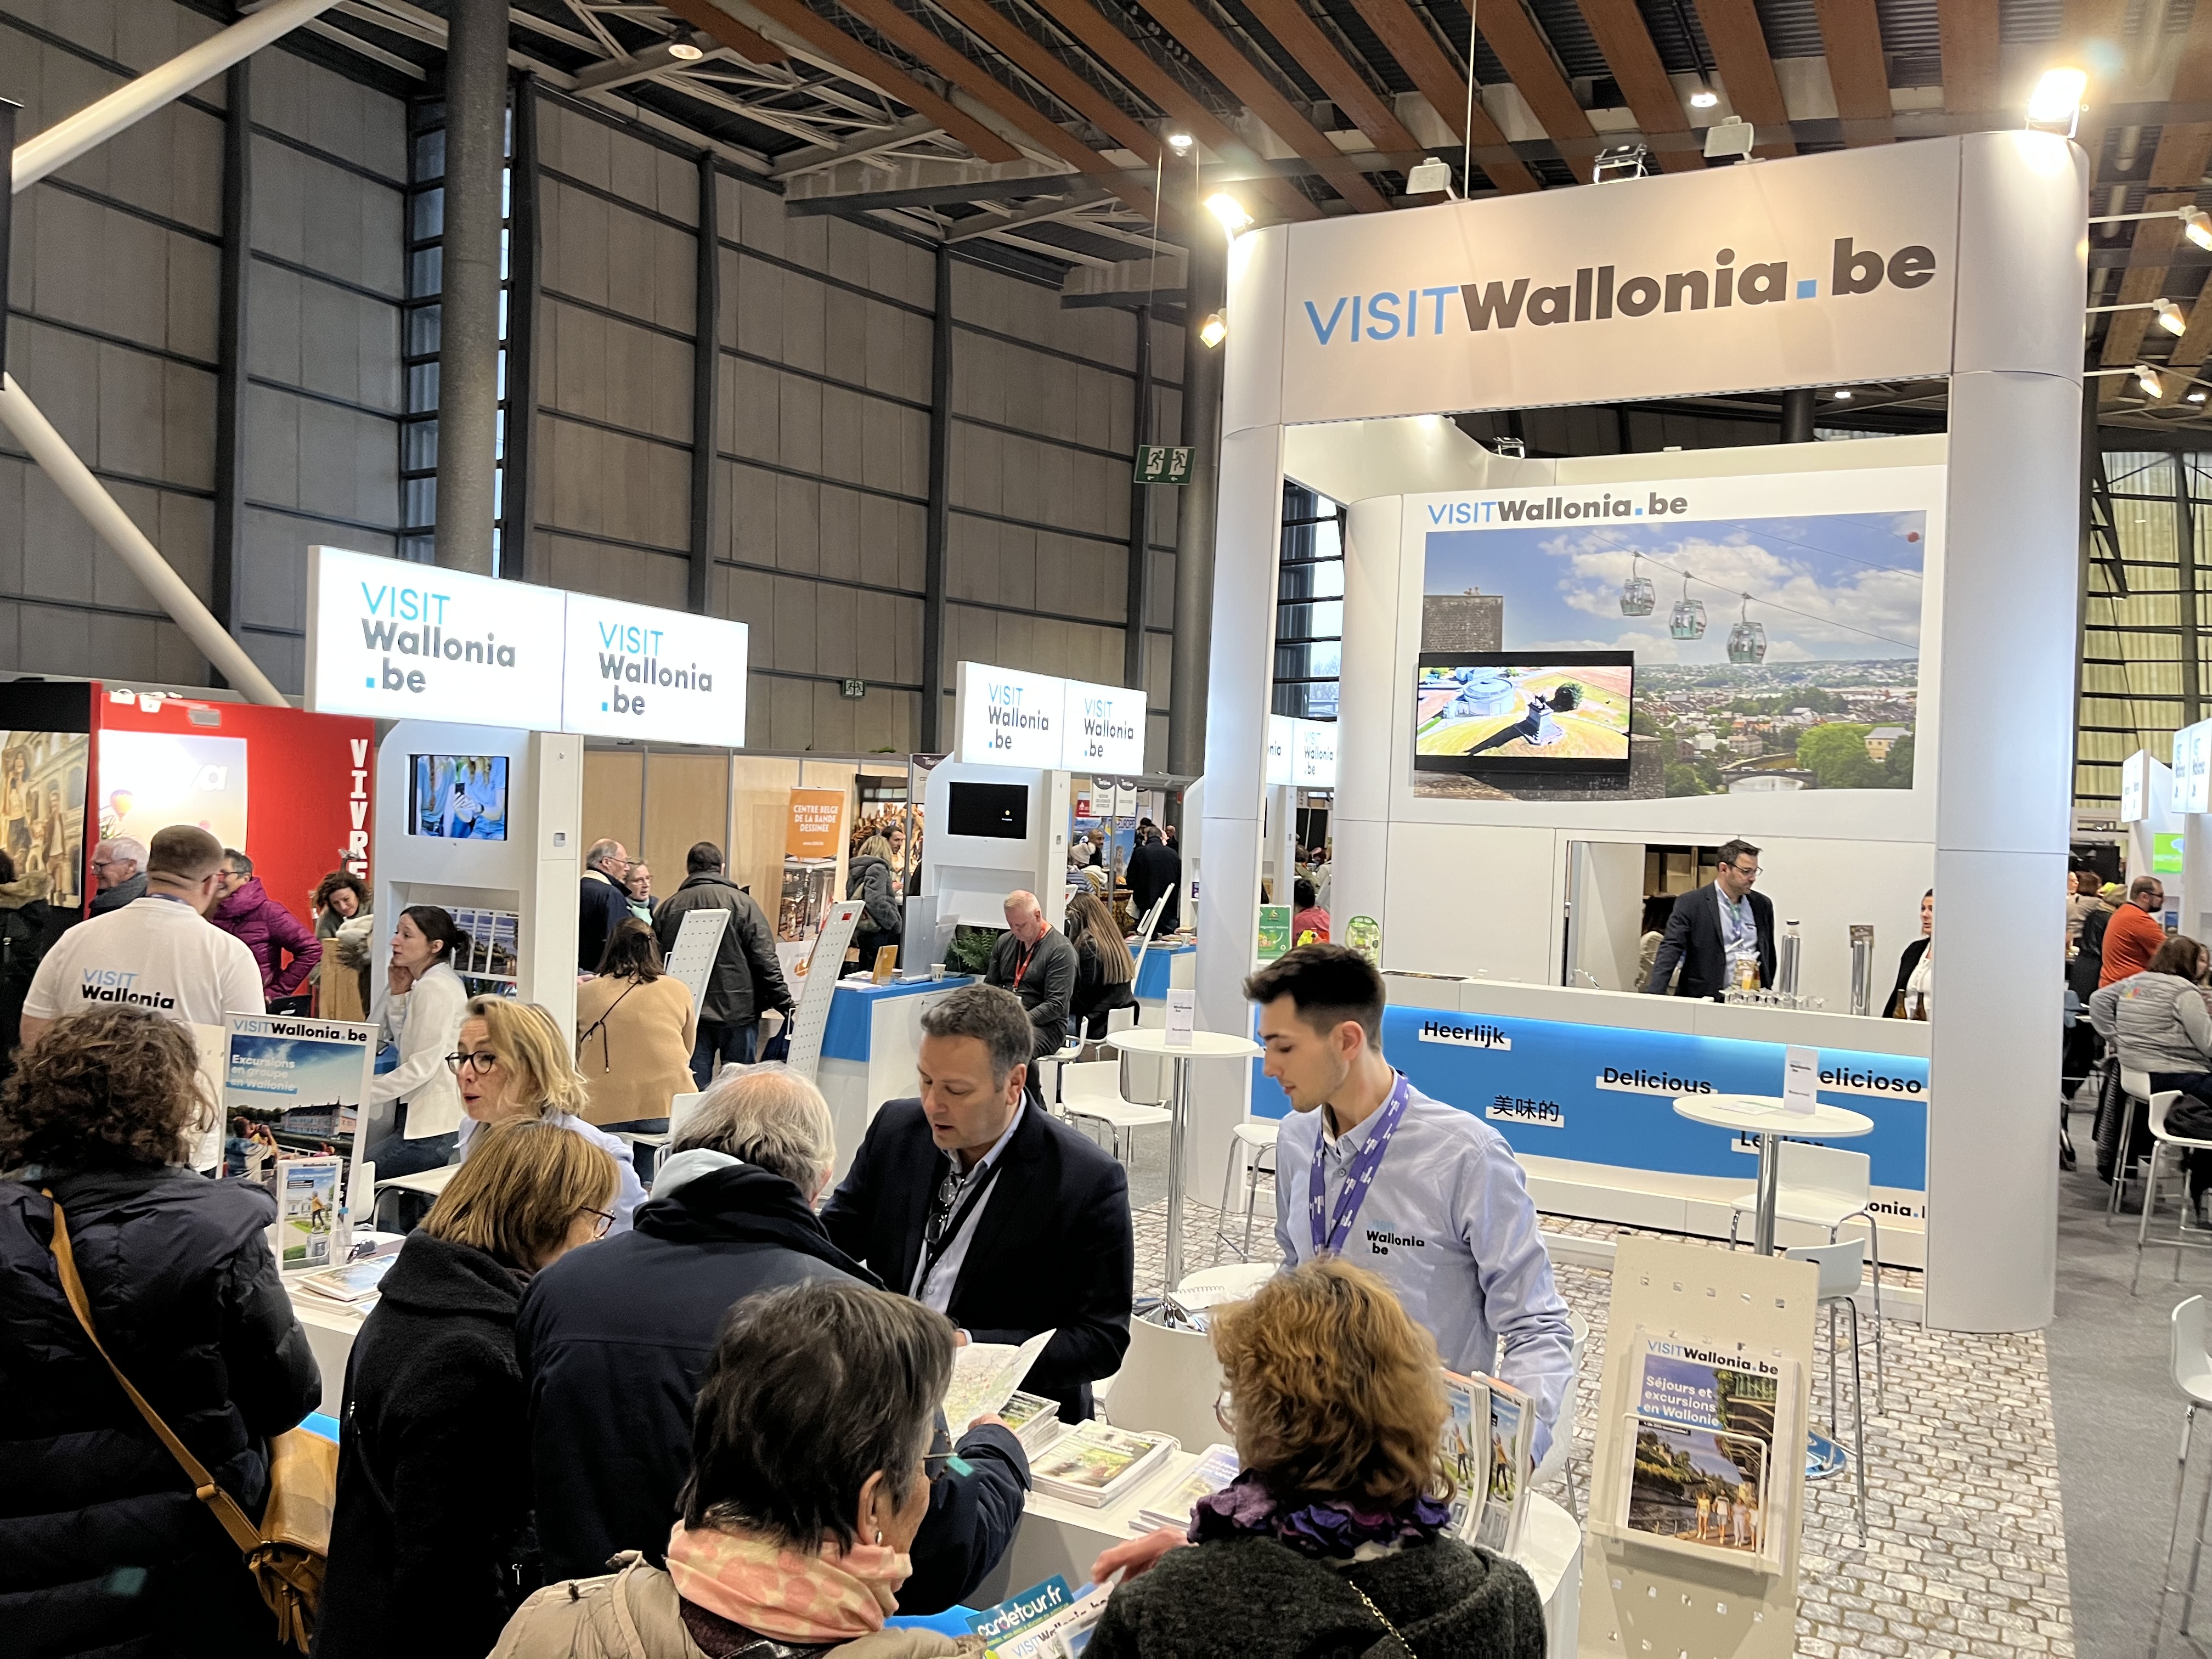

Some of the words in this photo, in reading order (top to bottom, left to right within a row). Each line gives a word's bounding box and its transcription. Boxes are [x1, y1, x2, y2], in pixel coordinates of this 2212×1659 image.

[1304, 237, 1937, 346] VISITWallonia.be
[1427, 492, 1689, 525] VISITWallonia.be
[360, 581, 450, 624] VISIT
[360, 618, 516, 668] Wallonia
[599, 621, 663, 656] VISIT
[366, 657, 426, 693] .be
[599, 652, 712, 692] Wallonia
[601, 686, 646, 715] .be
[989, 683, 1024, 706] VISIT
[989, 706, 1049, 730] Wallonia
[1084, 697, 1113, 718] VISIT
[989, 729, 1012, 749] .be
[1084, 718, 1134, 740] Wallonia
[1084, 738, 1104, 758] .be
[1304, 746, 1333, 760] Wallonia
[793, 804, 819, 814] CENTRE
[820, 805, 838, 814] BELGE
[794, 814, 804, 822] DE
[804, 815, 813, 823] LA
[814, 815, 836, 823] BANDE
[83, 968, 139, 988] VISIT
[82, 984, 175, 1009] Wallonia
[233, 1019, 368, 1042] VISITWallonia.be
[1424, 1021, 1505, 1048] Heerlijk
[231, 1066, 245, 1075] en
[246, 1068, 289, 1079] groupe
[232, 1054, 296, 1069] Excursions
[230, 1078, 244, 1087] en
[246, 1079, 295, 1092] Wallonie
[1603, 1067, 1712, 1094] Delicious
[1819, 1067, 1922, 1094] elicioso
[1493, 1095, 1560, 1122] 美味的
[1367, 1230, 1425, 1246] Wallonia
[1647, 1339, 1779, 1375] VISITWallonia.be
[1646, 1376, 1696, 1395] Séjours
[1699, 1388, 1712, 1398] et
[1645, 1390, 1718, 1413] excursions
[1643, 1403, 1660, 1415] en
[1662, 1405, 1720, 1427] Wallonie
[977, 1584, 1063, 1637] cardetour.fr
